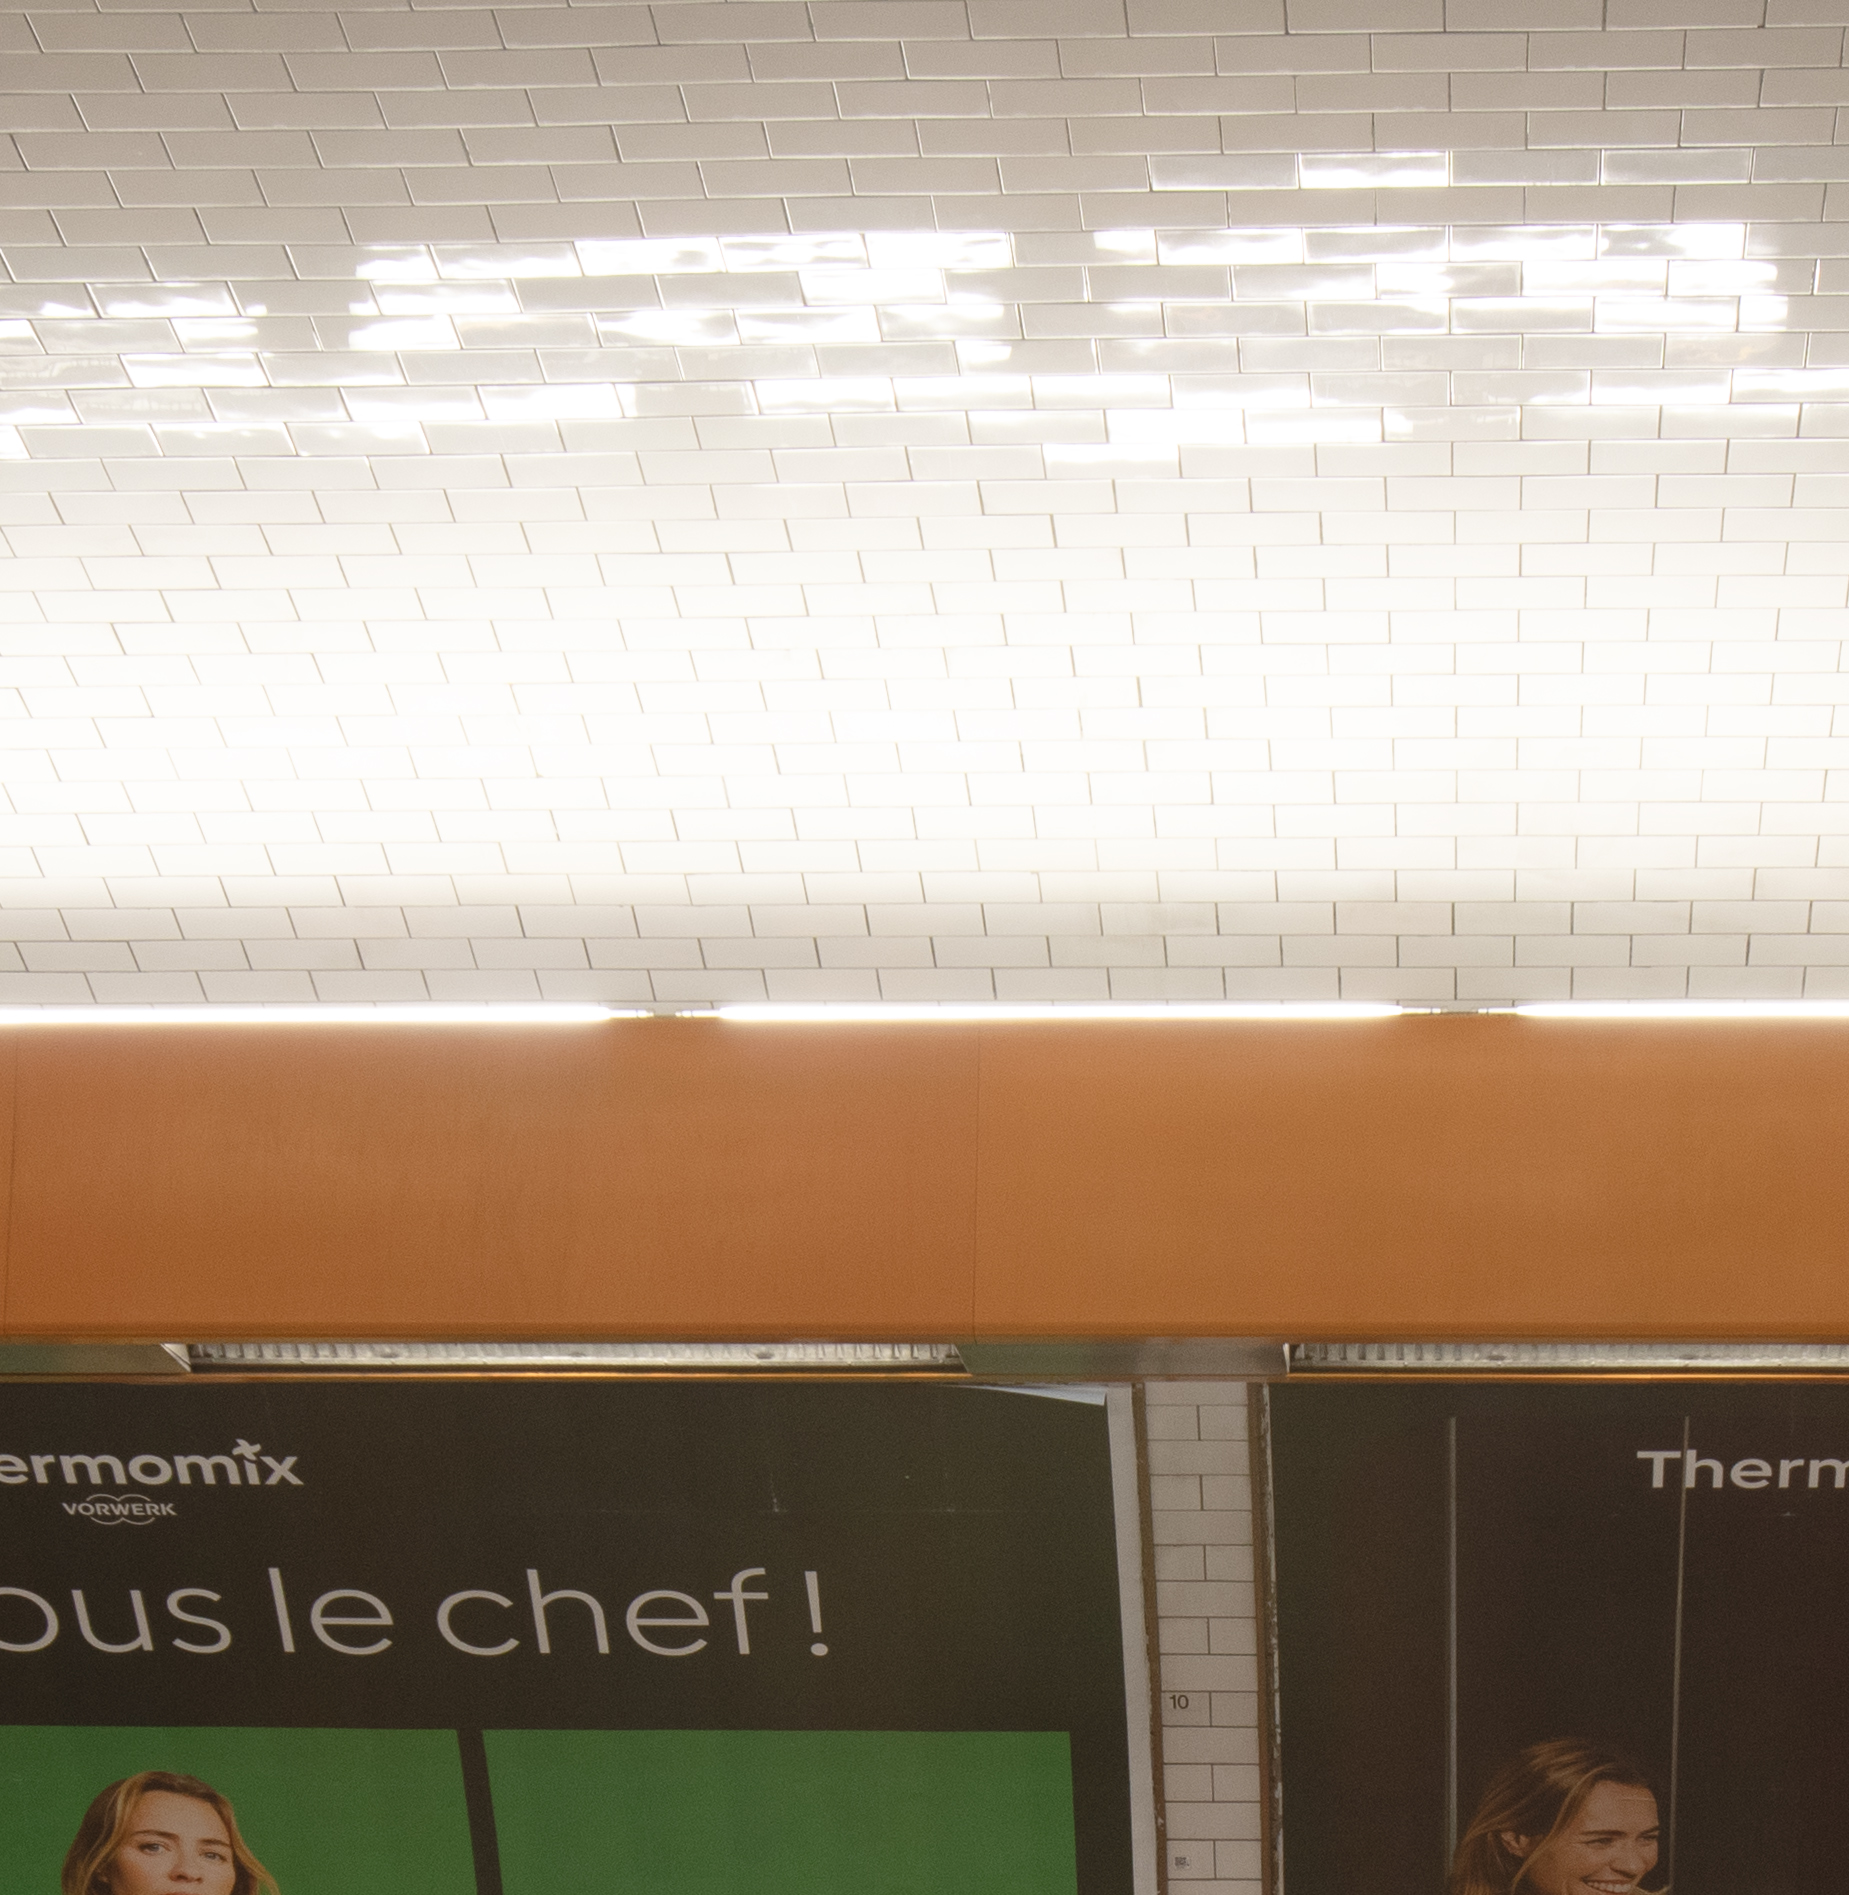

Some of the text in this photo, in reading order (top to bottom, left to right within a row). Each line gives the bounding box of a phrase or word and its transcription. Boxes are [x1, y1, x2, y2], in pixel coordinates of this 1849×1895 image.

[63, 1501, 177, 1518] VORWERK
[269, 1568, 393, 1655] le
[437, 1568, 768, 1656] chef
[1169, 1694, 1189, 1710] 10
